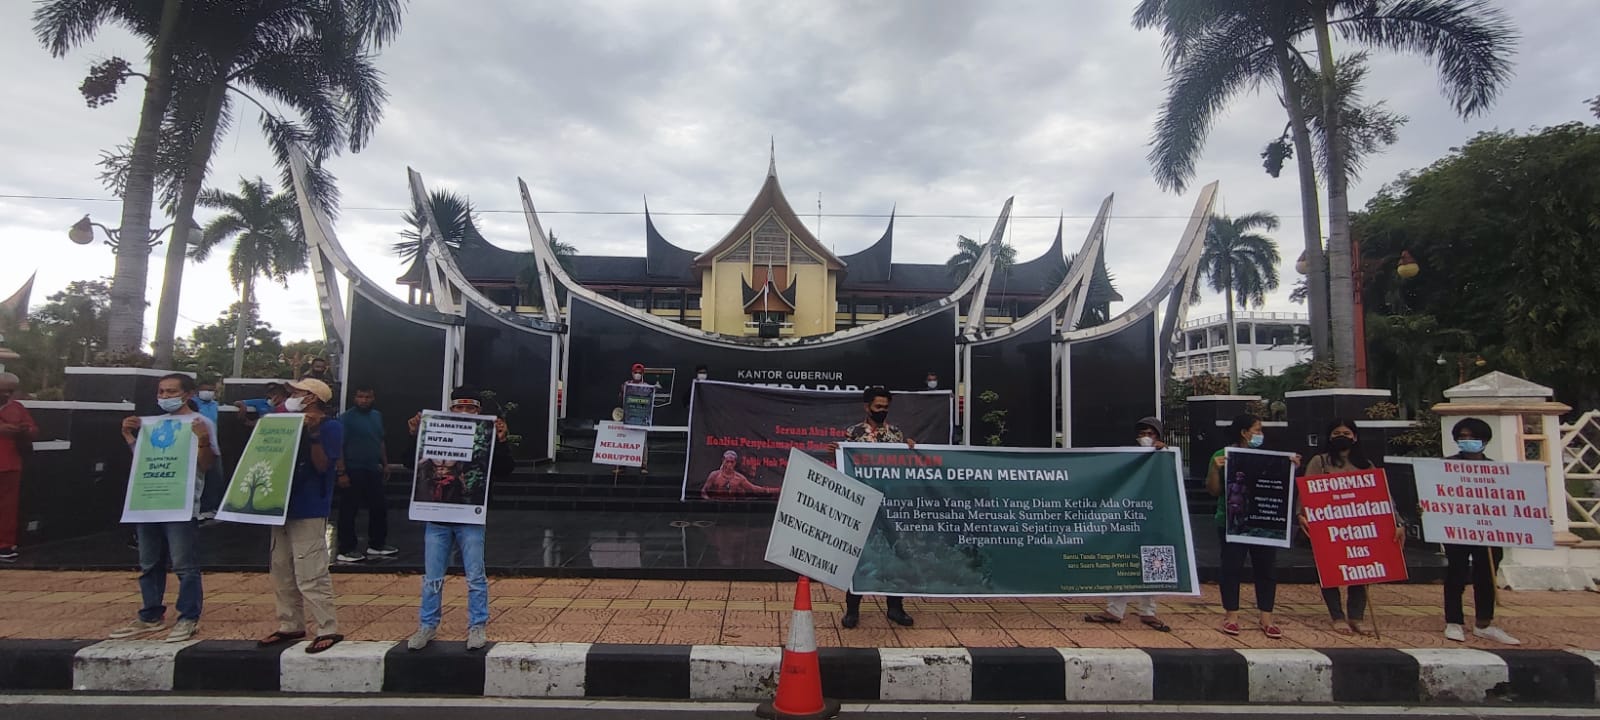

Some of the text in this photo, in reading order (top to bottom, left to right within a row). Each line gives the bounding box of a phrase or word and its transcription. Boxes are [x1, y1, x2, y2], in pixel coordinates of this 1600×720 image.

[738, 370, 843, 381] KANTOR GUBERNUR
[429, 422, 473, 430] SELAMATKAN
[775, 425, 807, 436] Seruan
[600, 441, 641, 450] MELAHAP
[426, 450, 467, 458] MENTAWAI
[595, 452, 641, 463] KORUPTOR
[853, 454, 943, 466] SELAMATKAN
[854, 467, 1069, 482] HUTAN MASA DEPAN MENTAWAI
[1444, 462, 1510, 475] Reformasi
[807, 469, 865, 506] REFORMASI
[1306, 474, 1376, 493] REFORMASI
[1436, 484, 1526, 501] Kedaulatan
[916, 497, 941, 509] Jiwa
[943, 498, 972, 511] Yang
[974, 497, 999, 508] Mati
[1002, 498, 1030, 511] Yang
[1033, 498, 1062, 509] Diam
[1064, 498, 1098, 509] Ketika
[1099, 498, 1120, 509] Ada
[1122, 499, 1154, 511] Orang
[1420, 499, 1548, 519] Masyarakat Adat
[797, 491, 862, 532] TIDAK UNTUK
[886, 509, 1147, 523] Lain Berusaha Merusak Sumber Kehidupan Kita,
[777, 511, 862, 559] MENGEKPLOITASI
[895, 521, 1141, 535] Karena Kita Mentawai Sejatinya Hidup Masih
[1327, 522, 1378, 543] Petani
[957, 534, 1084, 547] Bergantung Pada Alam
[1444, 526, 1534, 546] Wilayahnya
[1346, 546, 1370, 560] Atas
[789, 545, 839, 576] MENTAWAI
[1338, 561, 1387, 582] Tanah
